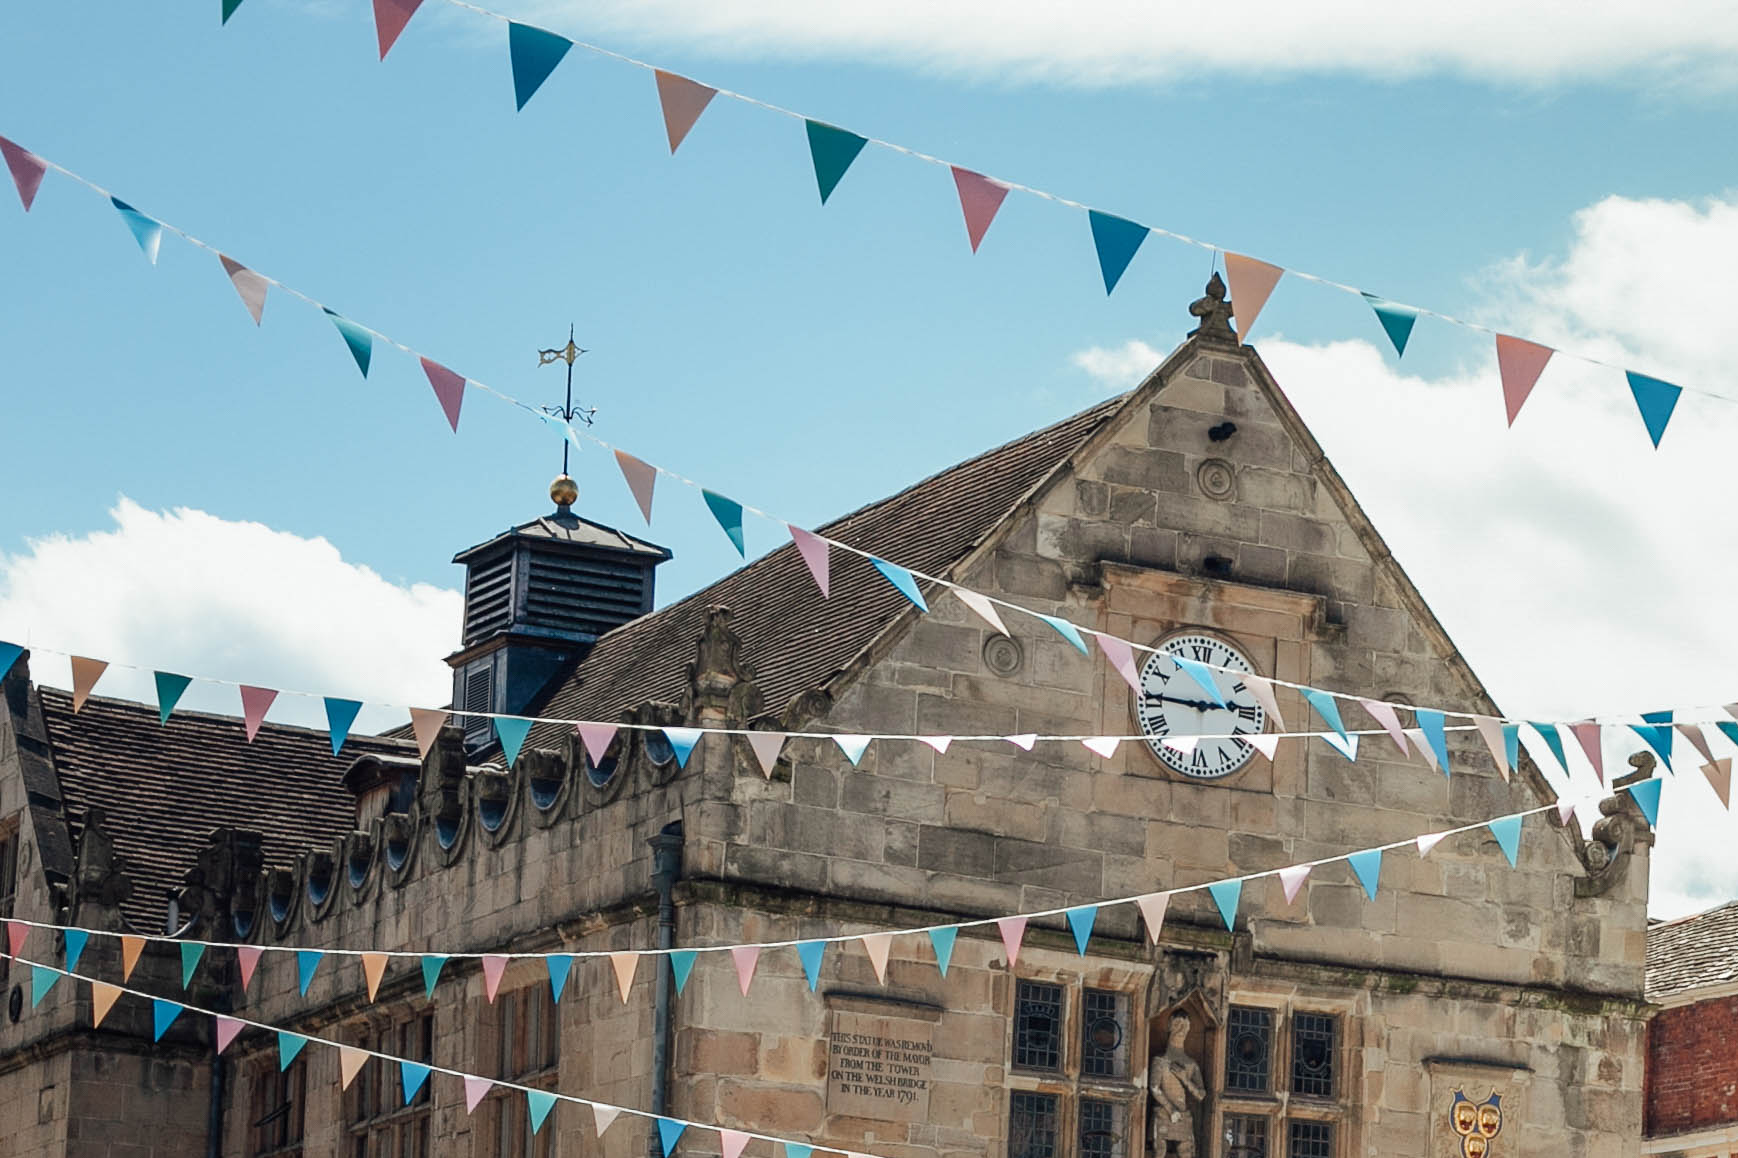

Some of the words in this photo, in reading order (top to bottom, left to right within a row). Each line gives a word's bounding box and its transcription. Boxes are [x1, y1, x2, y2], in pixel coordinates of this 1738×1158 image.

[831, 1032, 851, 1043] THIS
[853, 1034, 883, 1047] STATUE
[884, 1038, 901, 1049] WAS
[832, 1044, 843, 1054] BY
[843, 1046, 869, 1058] ORDER
[871, 1048, 881, 1059] OF
[885, 1050, 900, 1060] THE
[902, 1052, 931, 1065] MAYOR
[840, 1058, 864, 1070] FROM
[865, 1061, 883, 1072] THE
[887, 1063, 920, 1076] TOWER
[831, 1070, 843, 1080] ON
[845, 1071, 864, 1081] THE
[865, 1073, 896, 1087] WELSH
[897, 1078, 928, 1090] BRIDGE
[840, 1083, 851, 1093] IN
[852, 1084, 872, 1096] THE
[873, 1086, 895, 1099] YEAR
